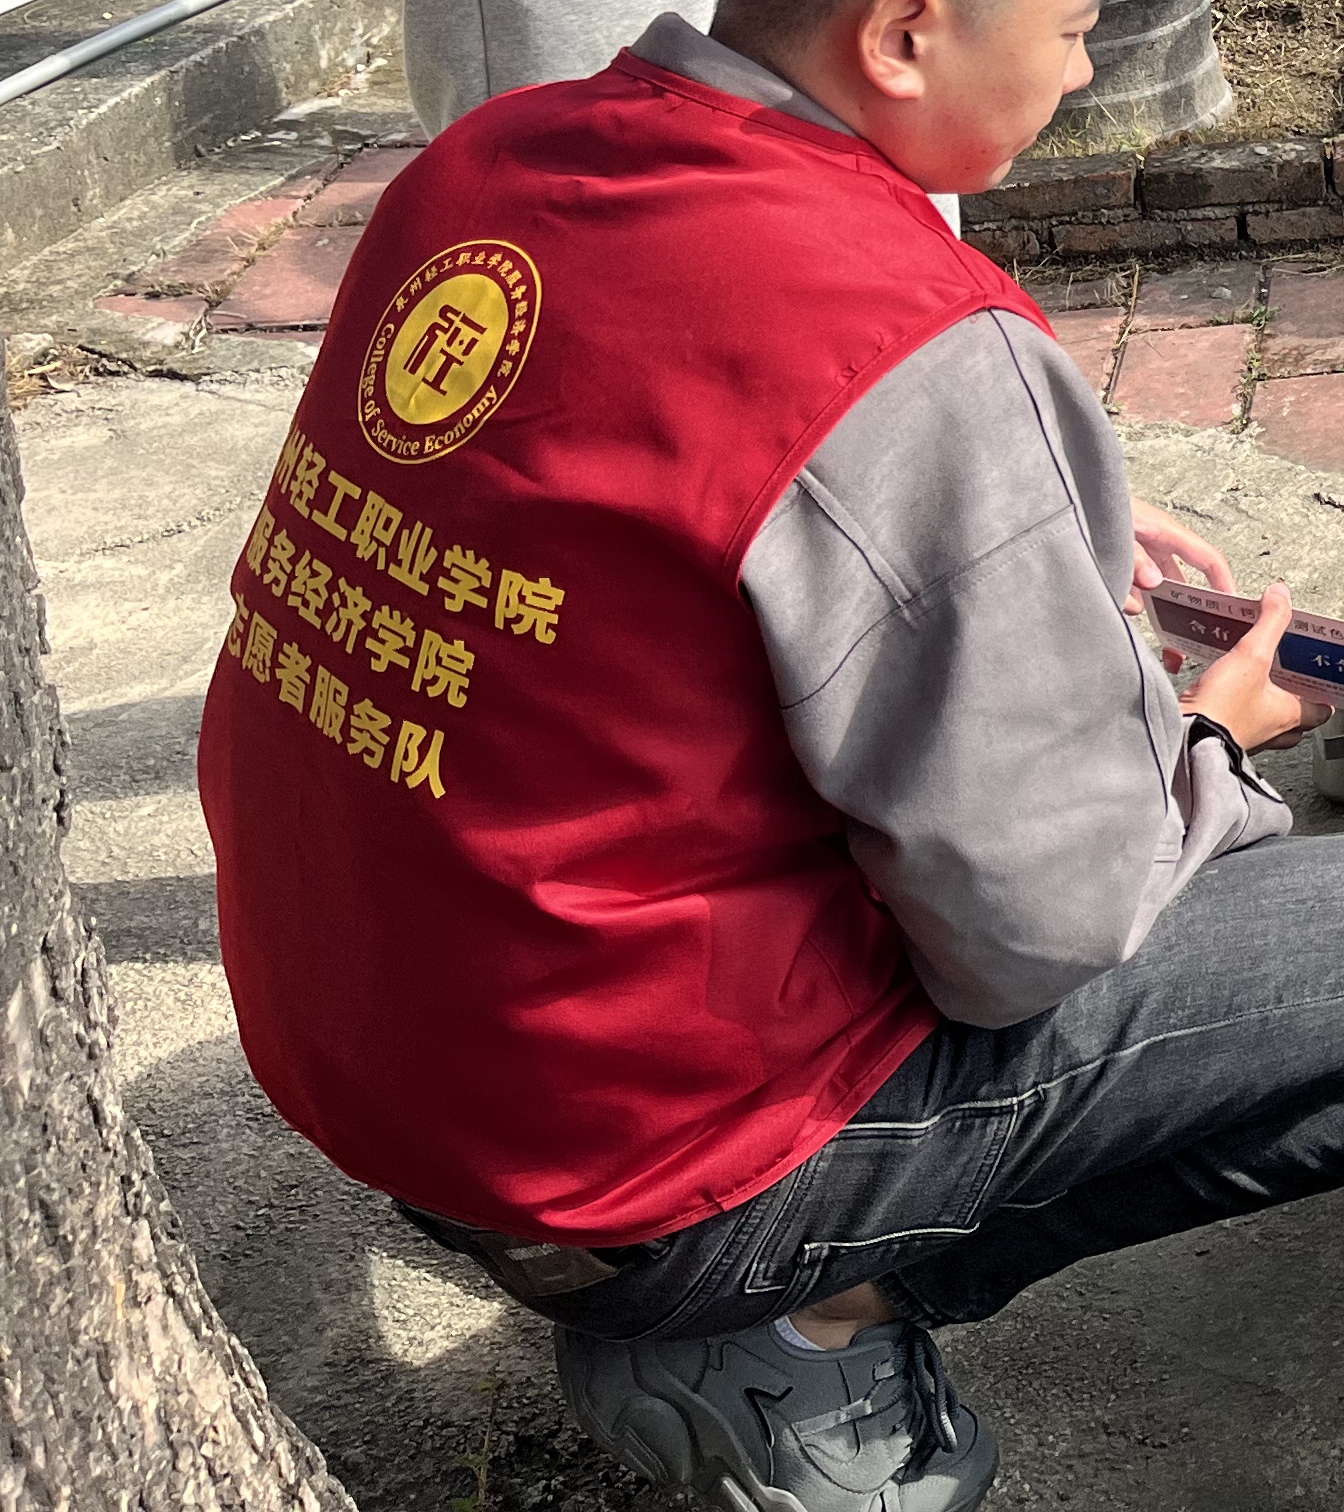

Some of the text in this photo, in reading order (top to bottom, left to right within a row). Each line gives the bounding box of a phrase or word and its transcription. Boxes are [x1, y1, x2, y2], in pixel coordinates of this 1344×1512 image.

[361, 322, 498, 456] College of Service Economy
[247, 504, 476, 708] 服务经济学院
